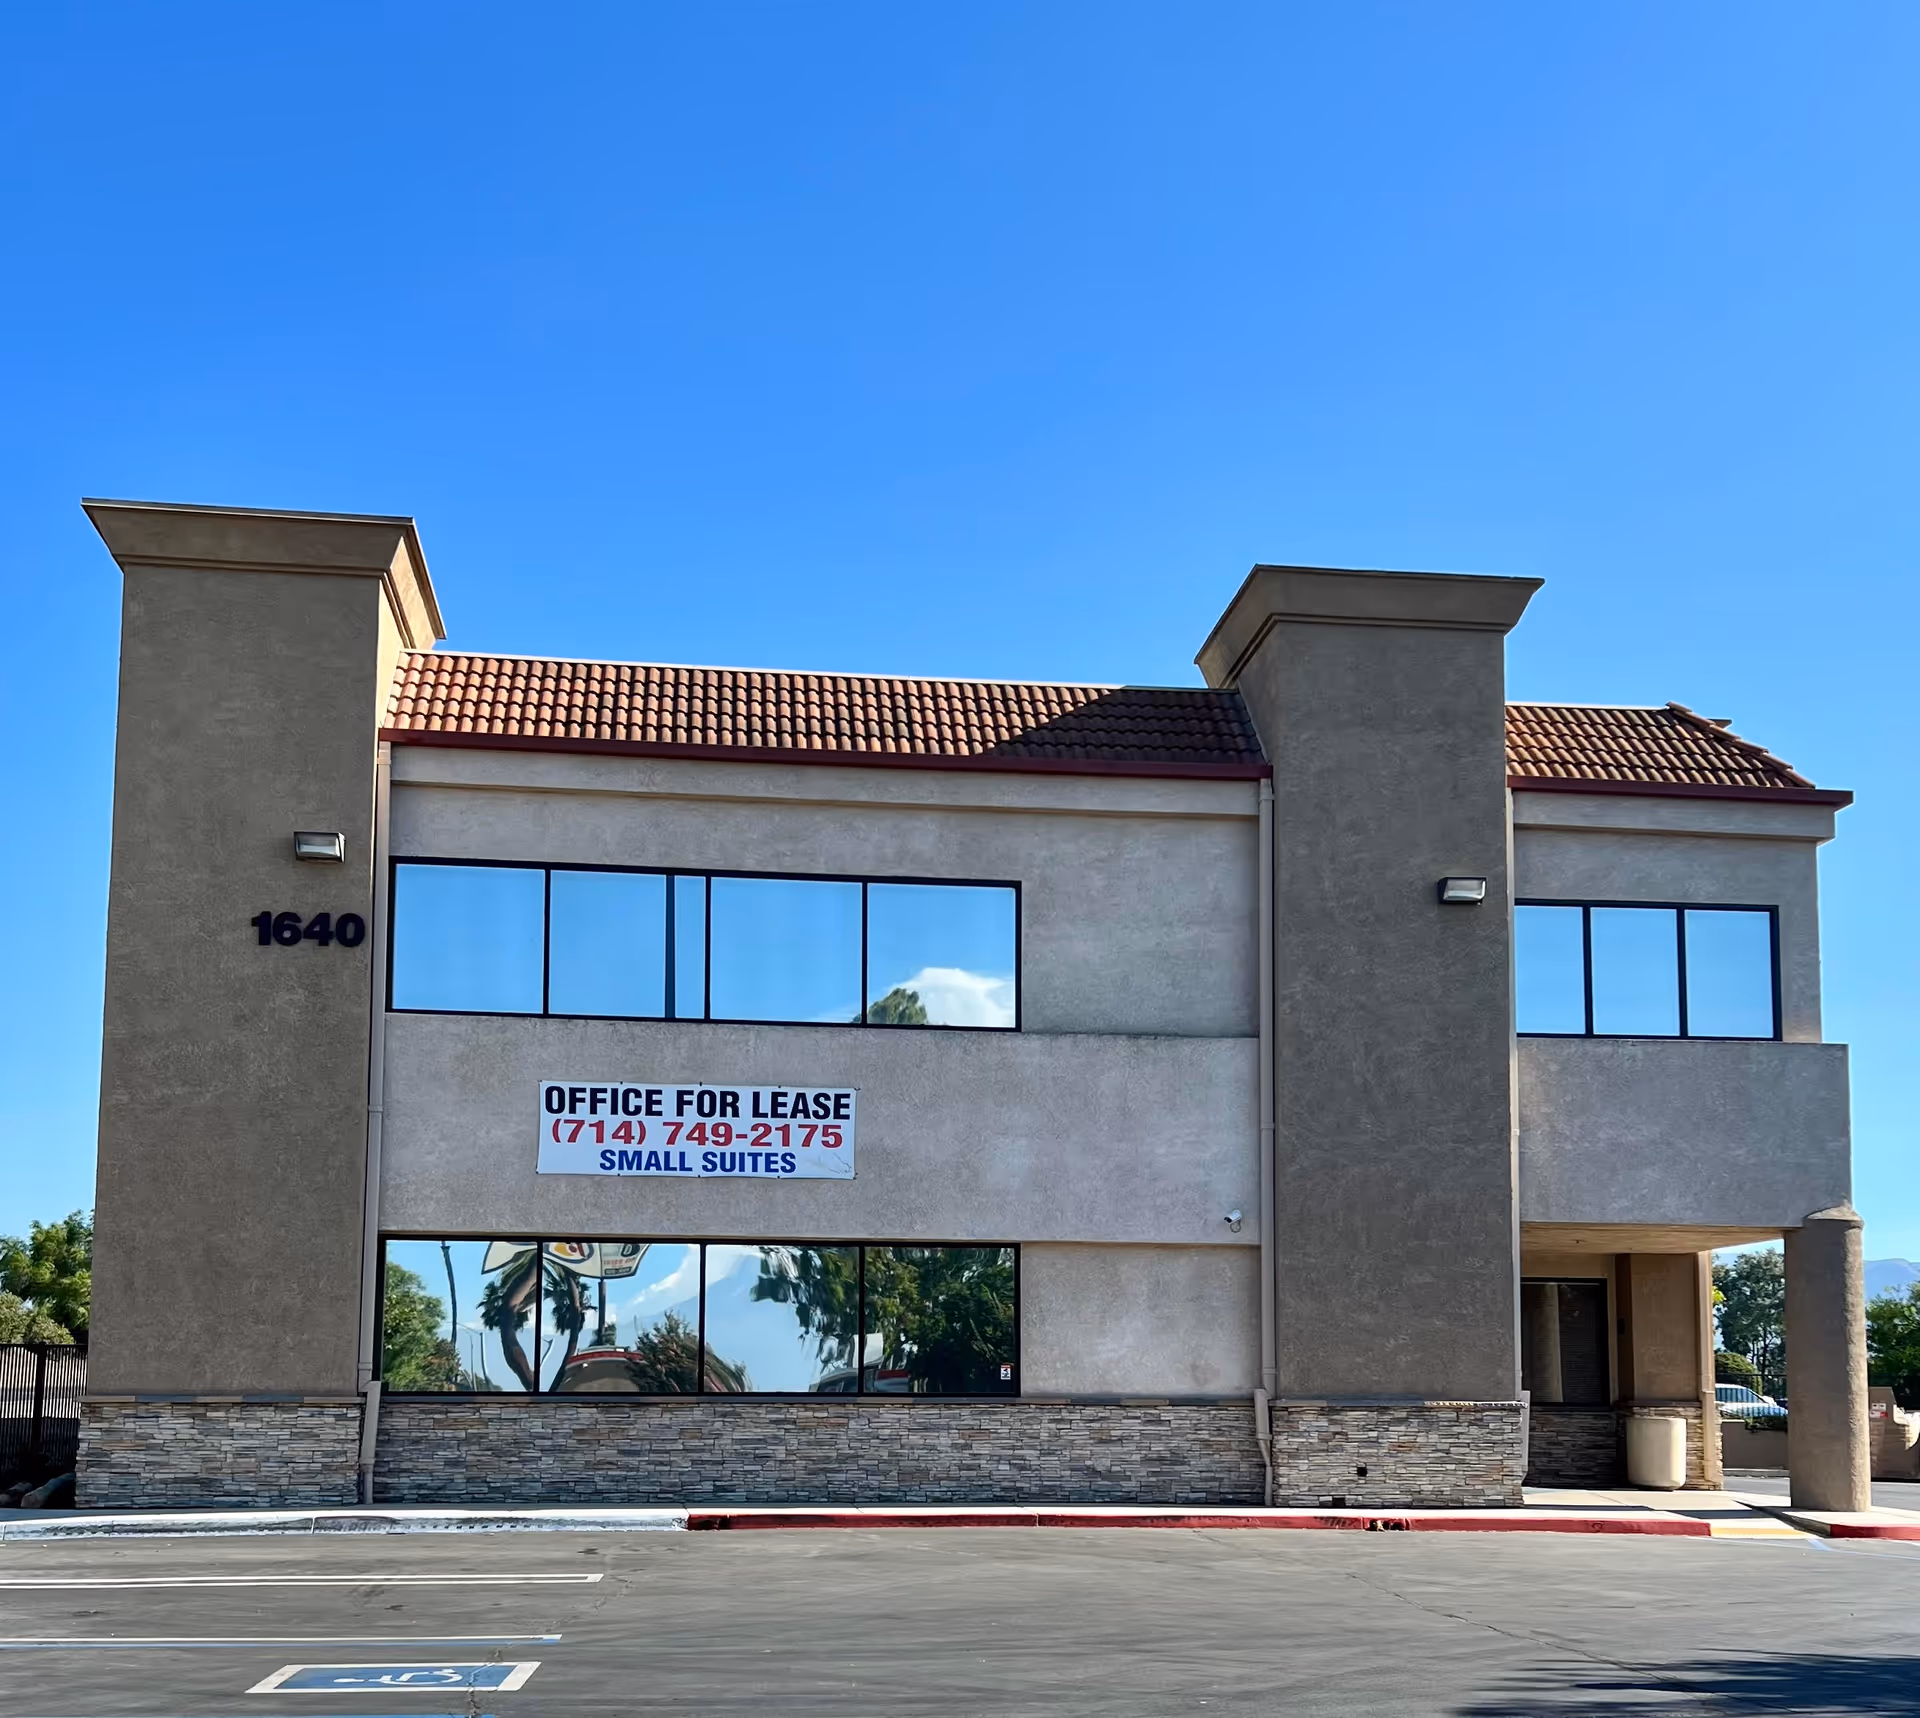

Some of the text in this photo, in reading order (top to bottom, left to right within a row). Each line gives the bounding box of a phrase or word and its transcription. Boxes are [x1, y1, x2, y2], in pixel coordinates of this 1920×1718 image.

[251, 911, 366, 948] 1640
[545, 1085, 852, 1120] OFFICE FOR LEASE
[552, 1118, 843, 1149] (714) 749-2175
[599, 1149, 797, 1174] SMALL SUITES
